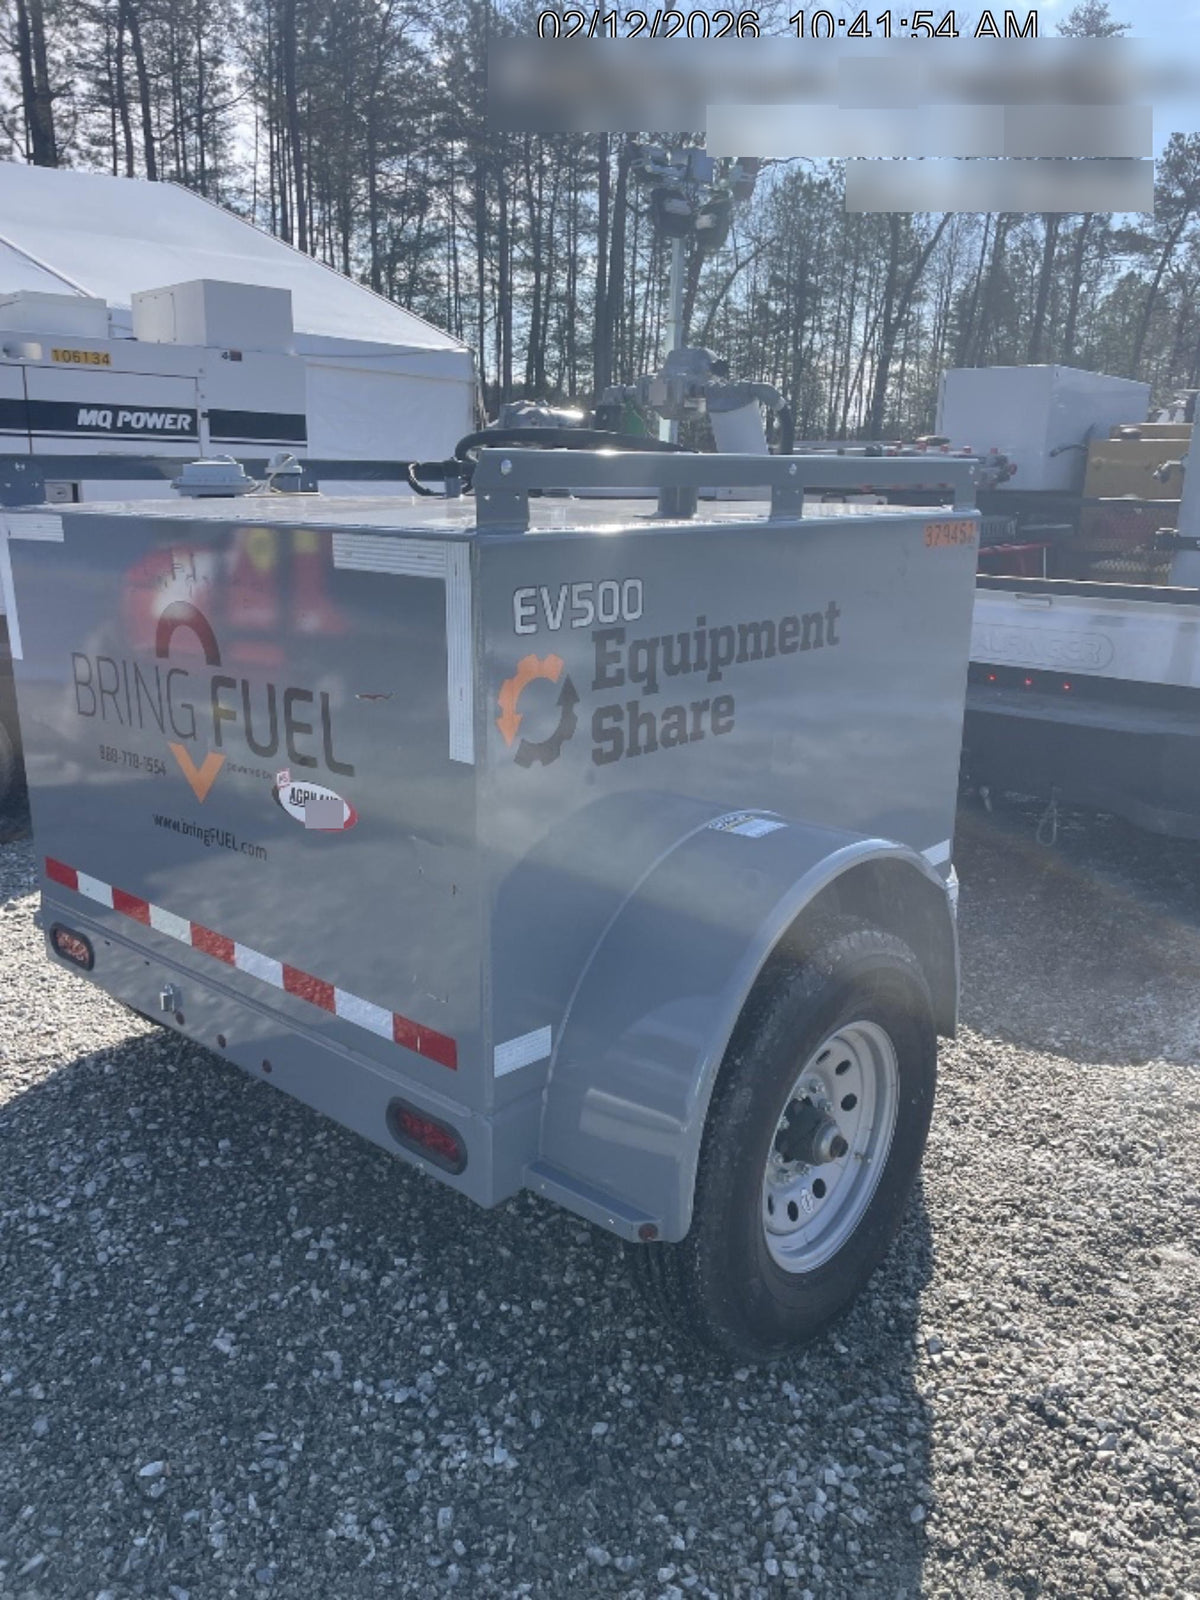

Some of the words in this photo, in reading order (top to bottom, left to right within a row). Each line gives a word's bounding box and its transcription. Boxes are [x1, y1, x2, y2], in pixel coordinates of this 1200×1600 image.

[52, 349, 111, 366] 106134
[77, 408, 112, 430] MQ
[117, 411, 192, 431] POWER
[512, 578, 645, 636] EV500
[591, 600, 841, 696] Equipment
[71, 651, 198, 741] BRING
[210, 674, 355, 778] FUEL
[591, 693, 736, 767] Share
[152, 813, 268, 861] www.bringFUEL.com
